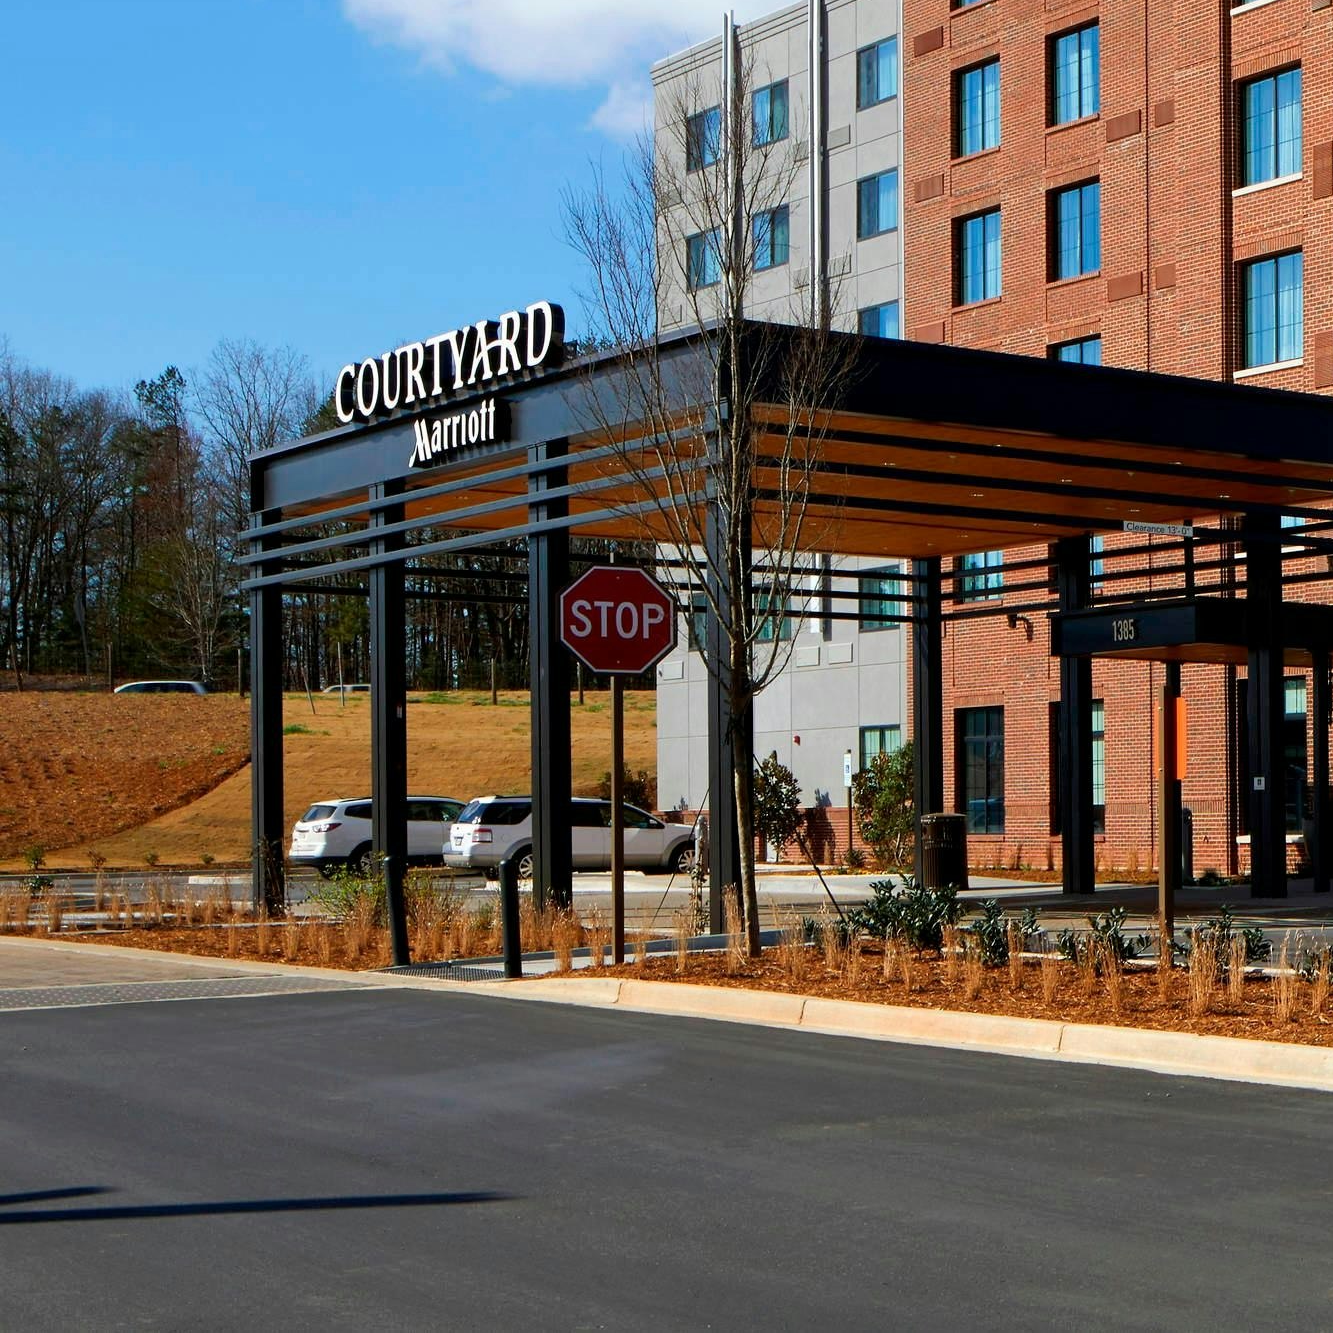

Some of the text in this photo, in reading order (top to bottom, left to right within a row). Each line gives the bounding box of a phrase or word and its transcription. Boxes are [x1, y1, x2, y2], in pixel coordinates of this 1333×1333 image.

[335, 300, 555, 423] COURTYARD
[408, 398, 496, 468] Marriott
[1126, 522, 1165, 533] Clearance
[570, 599, 665, 639] STOP
[1112, 619, 1135, 642] 1385
